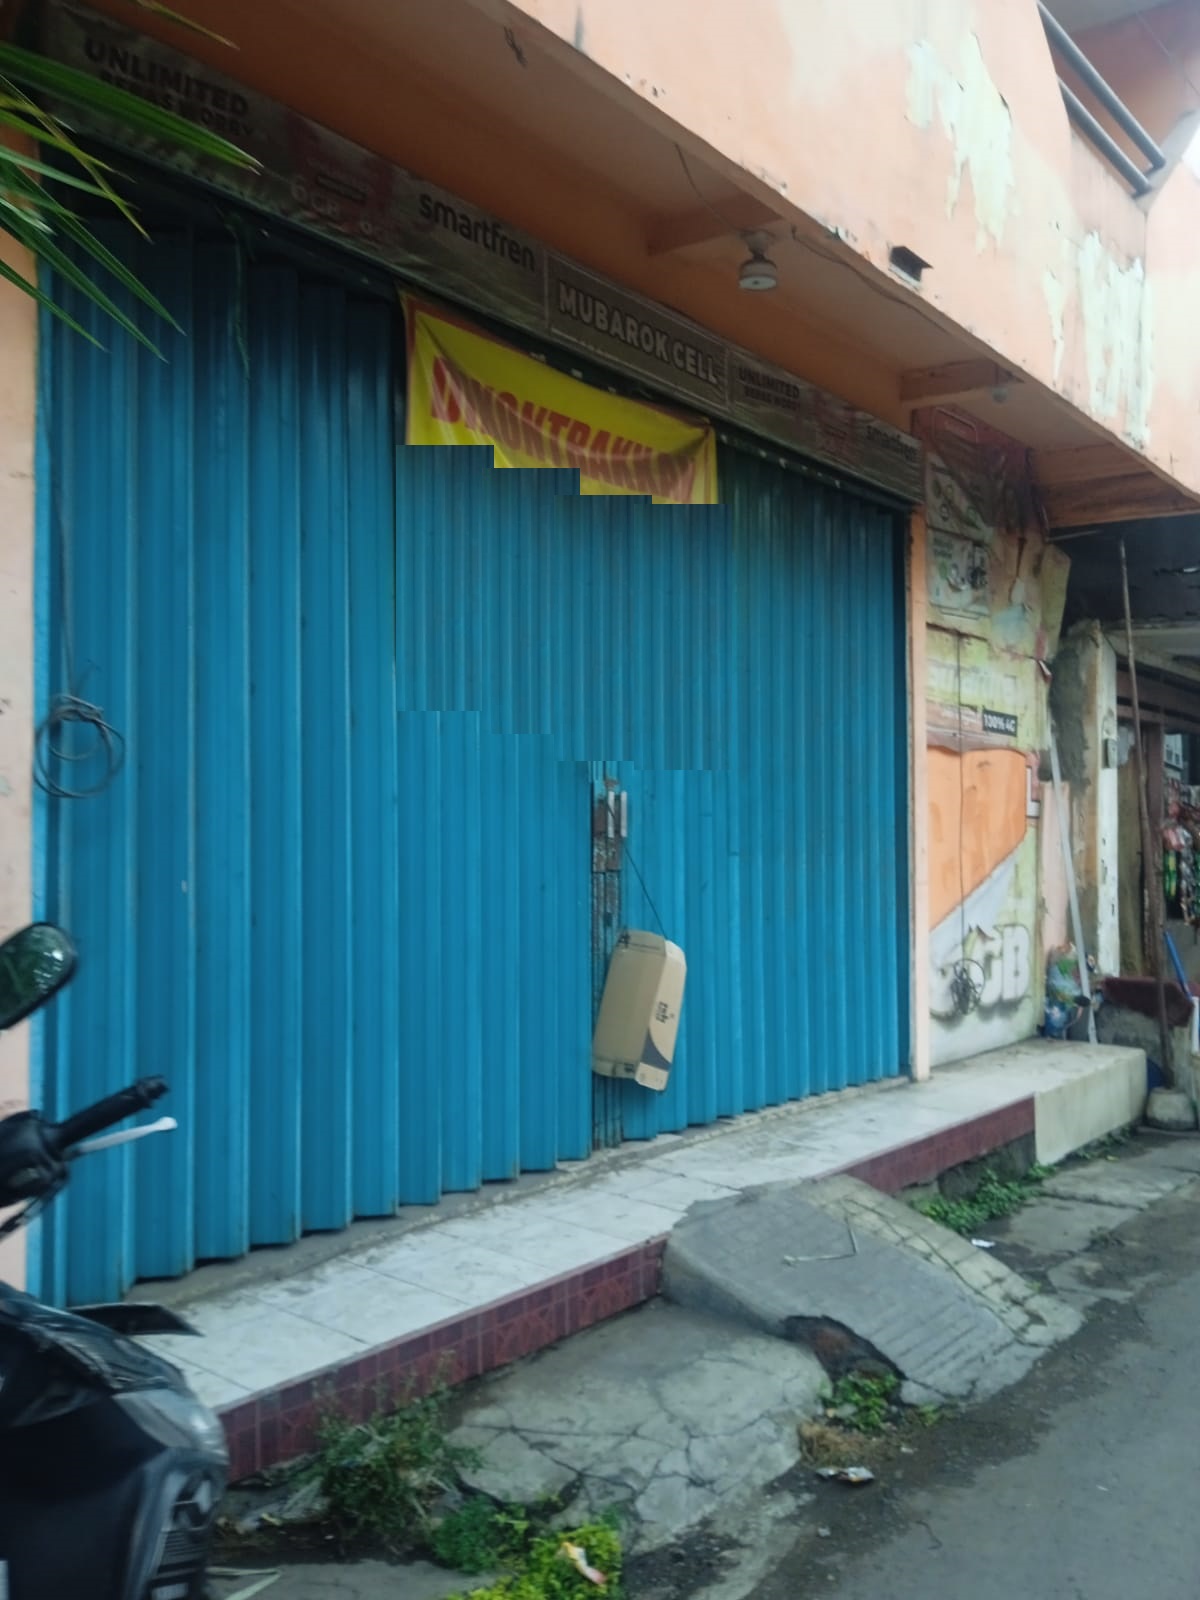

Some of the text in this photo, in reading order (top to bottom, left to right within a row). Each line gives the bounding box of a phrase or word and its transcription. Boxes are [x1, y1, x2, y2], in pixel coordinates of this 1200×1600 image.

[84, 37, 249, 116] UNLIMITED
[418, 194, 536, 272] smartfren
[558, 281, 719, 385] MUBAROK CELL
